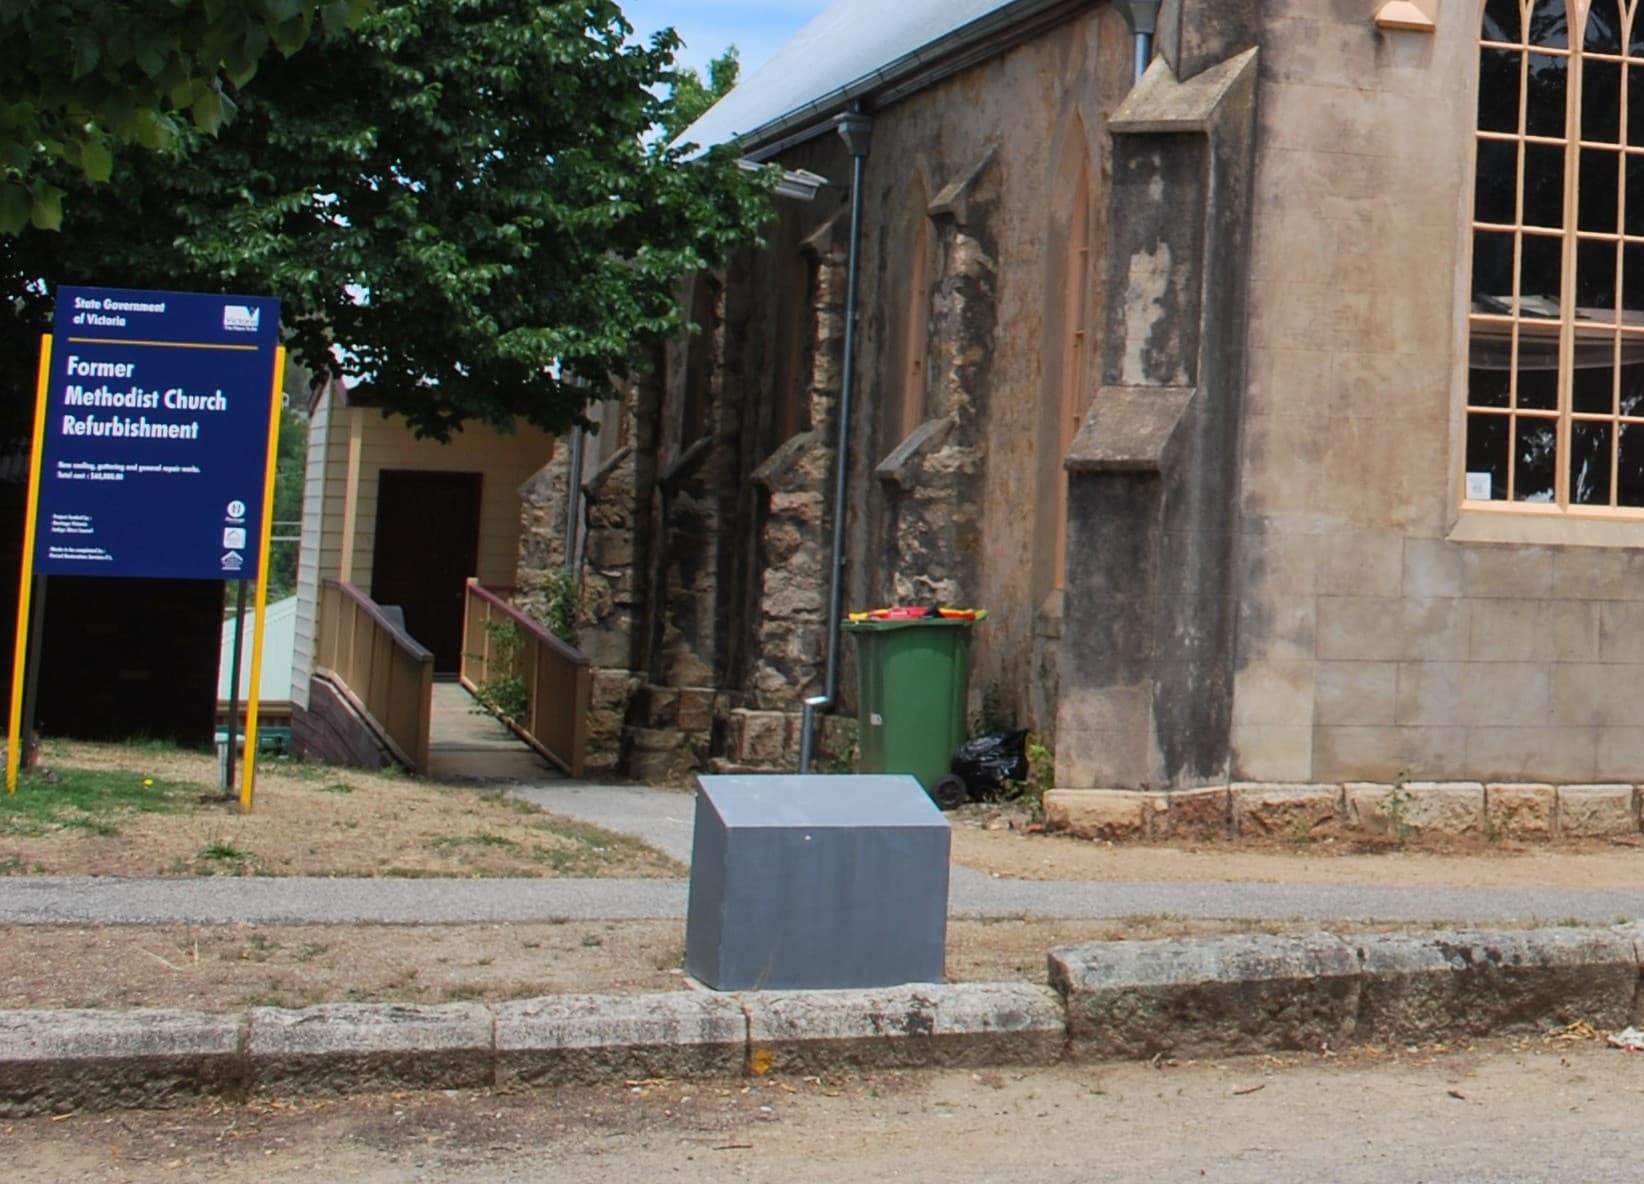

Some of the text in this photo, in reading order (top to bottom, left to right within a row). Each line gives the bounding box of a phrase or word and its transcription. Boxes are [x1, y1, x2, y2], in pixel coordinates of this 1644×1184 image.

[74, 297, 166, 313] State Government
[73, 313, 127, 326] of Victoria
[67, 356, 135, 378] Former
[64, 385, 228, 411] Methodist Church
[62, 415, 199, 439] Refurbishment
